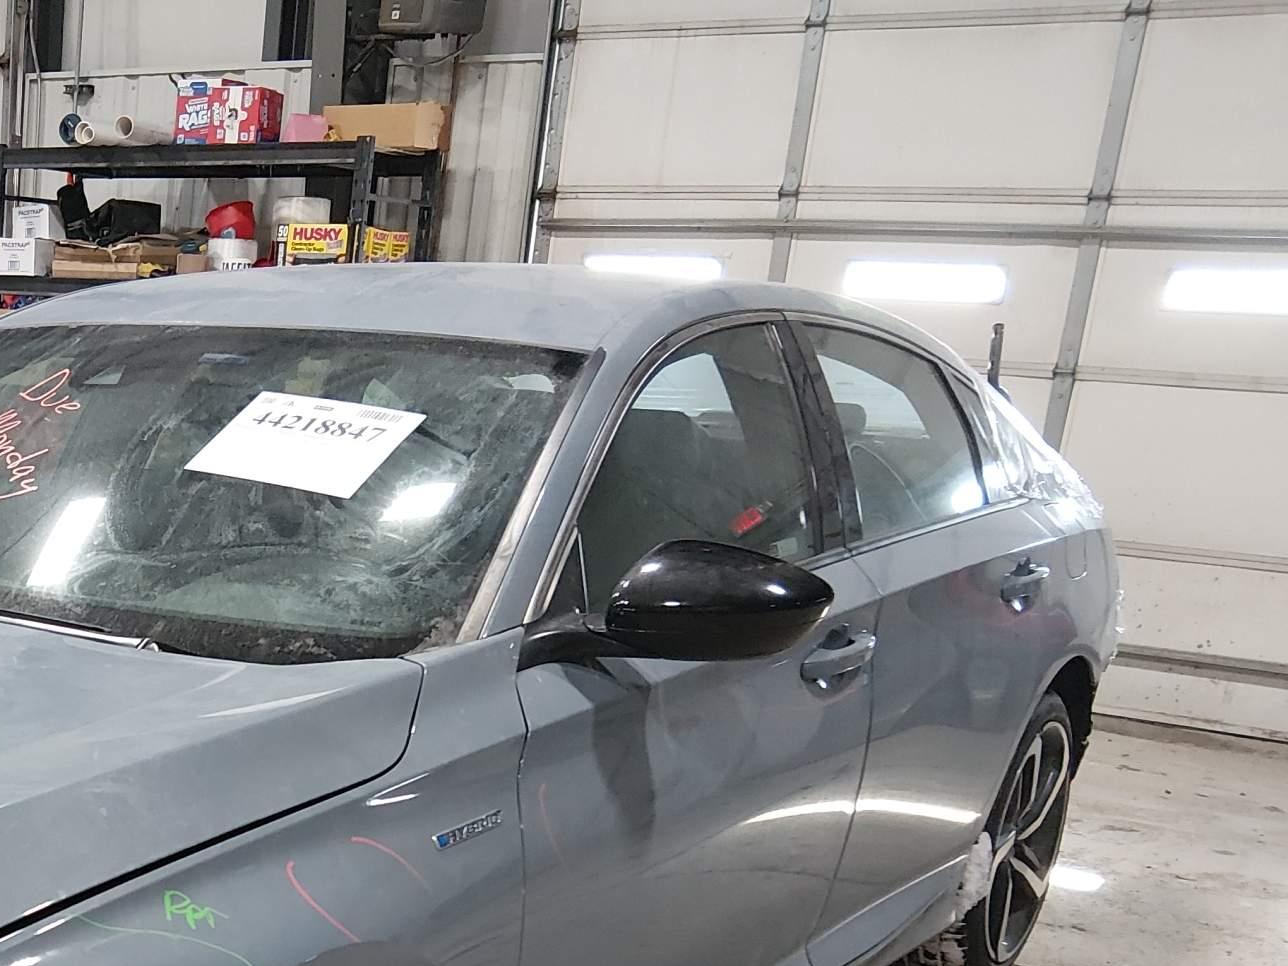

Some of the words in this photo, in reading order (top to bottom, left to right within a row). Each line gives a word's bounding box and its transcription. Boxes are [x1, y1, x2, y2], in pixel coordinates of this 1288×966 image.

[278, 225, 288, 237] 50
[292, 227, 342, 241] HUSKY
[18, 368, 81, 415] Due
[252, 411, 388, 442] 44218847
